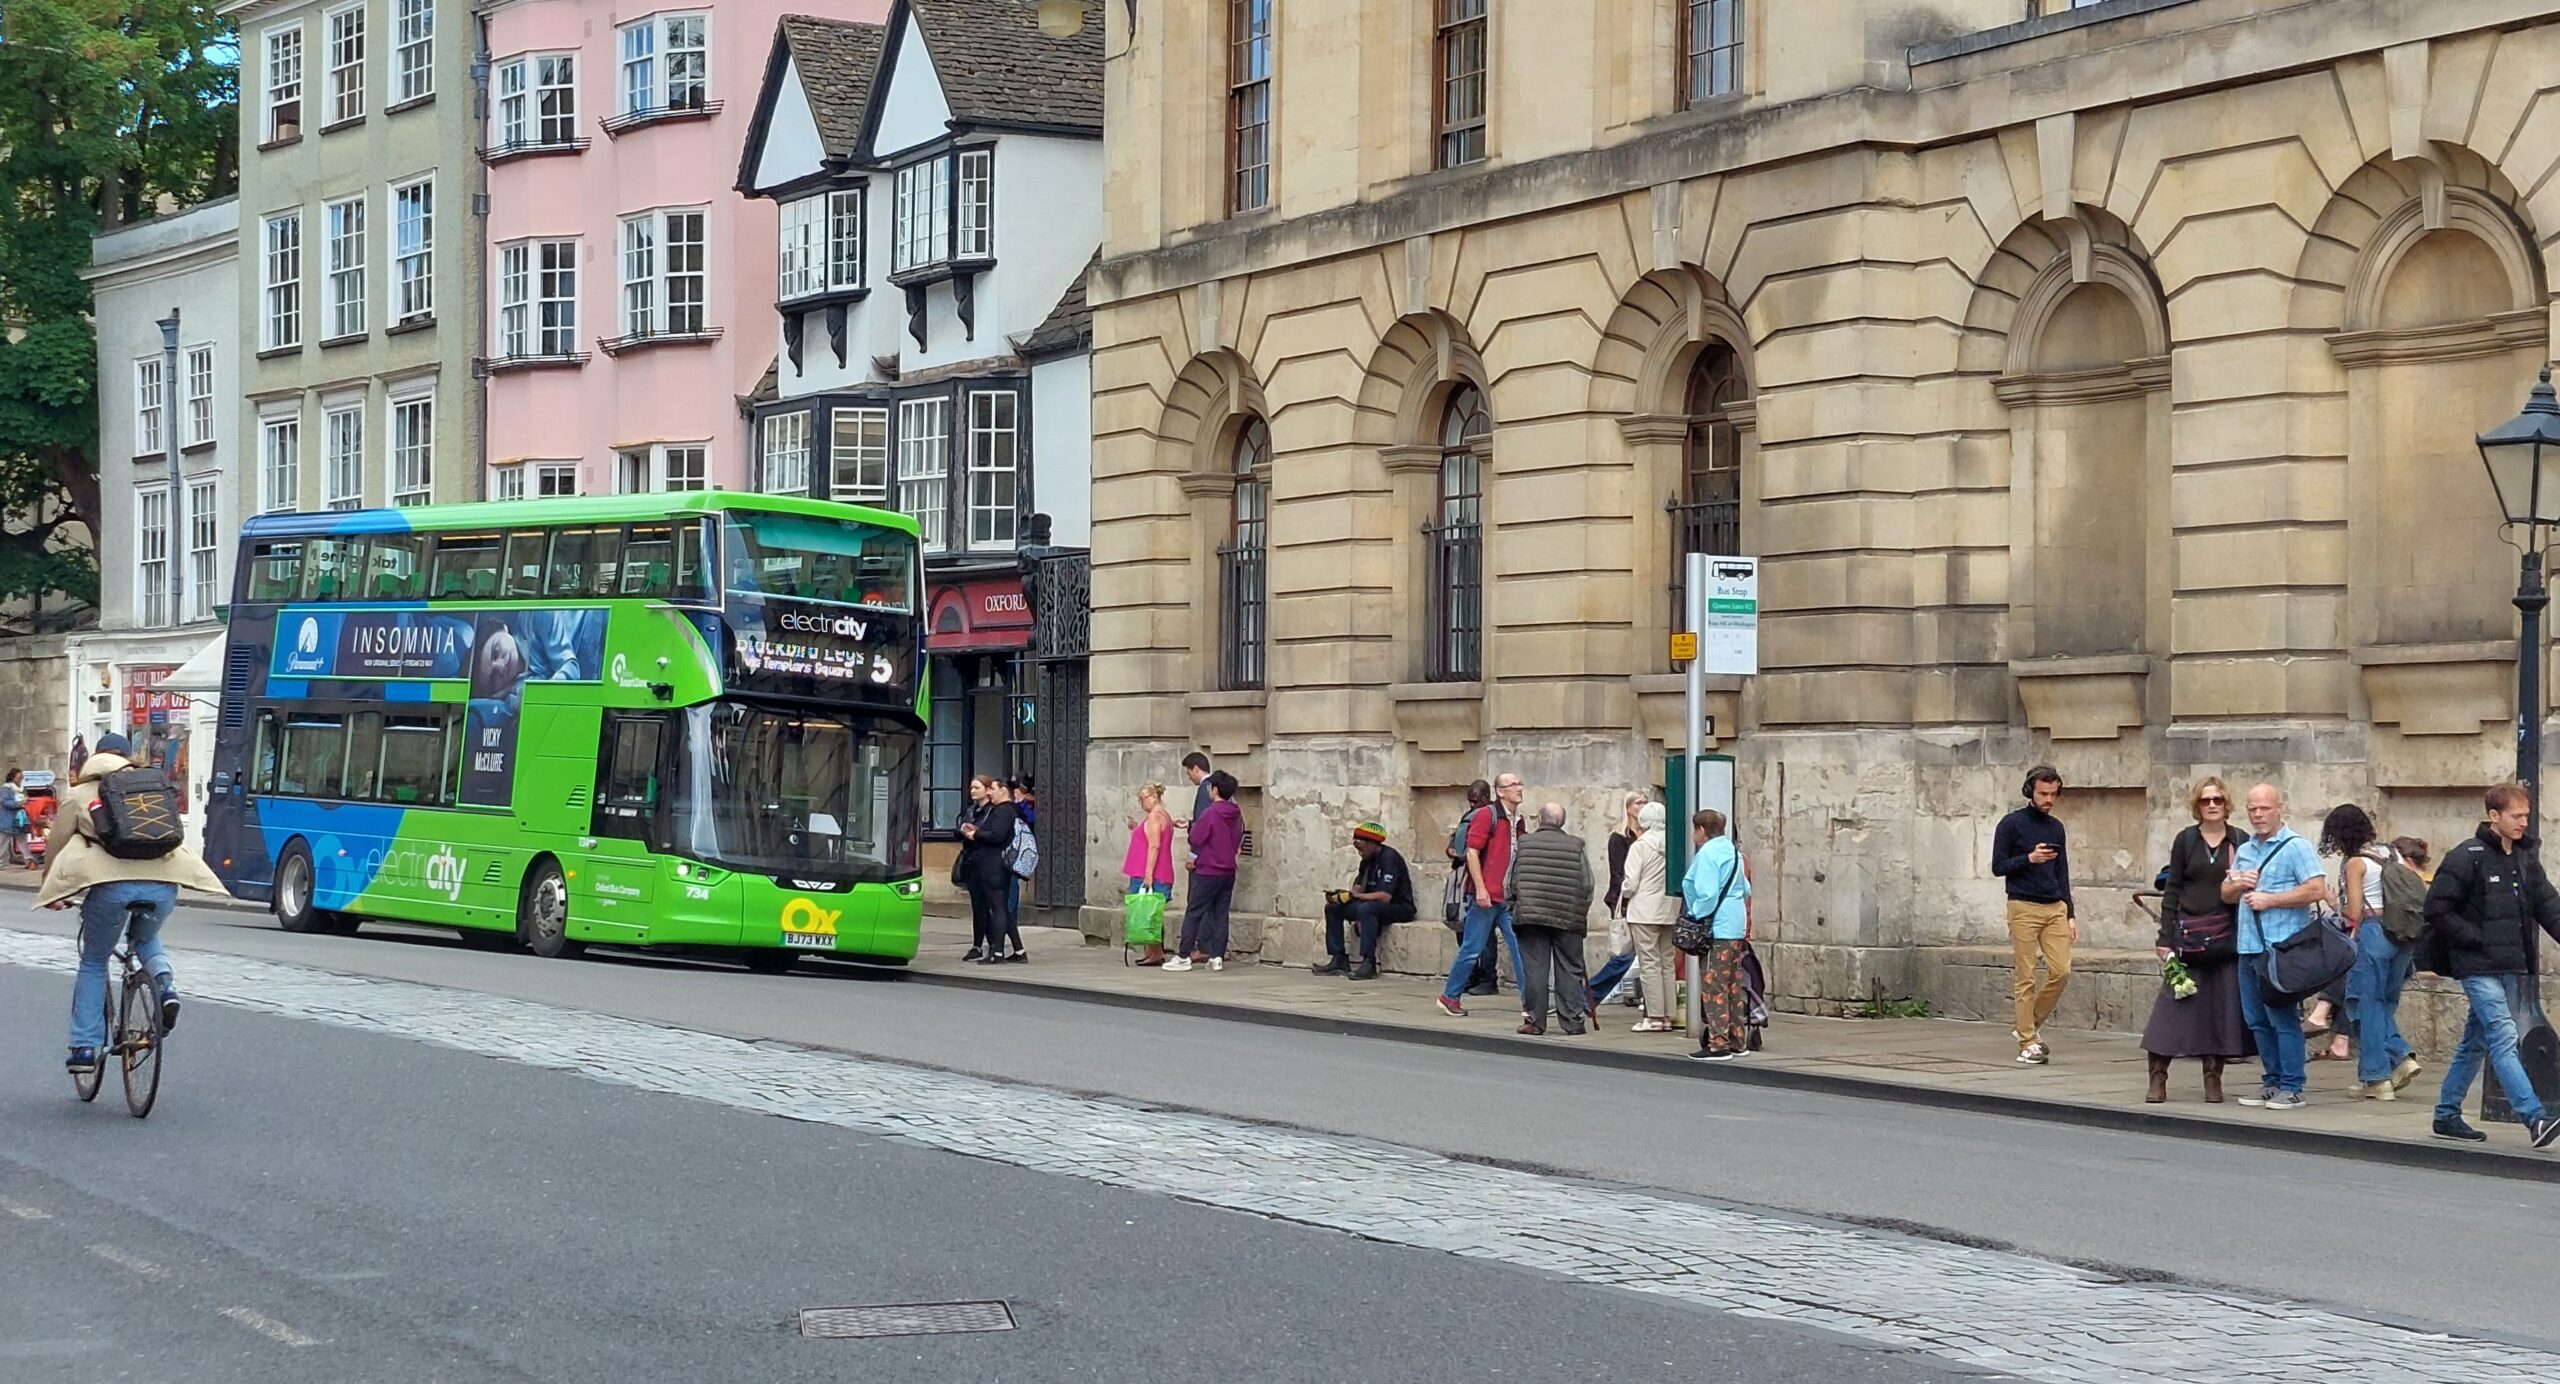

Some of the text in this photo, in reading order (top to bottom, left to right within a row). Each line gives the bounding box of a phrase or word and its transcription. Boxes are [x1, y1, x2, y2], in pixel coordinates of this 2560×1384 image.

[1717, 586, 1748, 598] Bus Stop
[780, 609, 867, 641] electricity
[352, 625, 456, 654] INSOMNIA
[763, 656, 813, 674] Templars
[814, 662, 854, 678] Square
[870, 654, 894, 684] 5
[483, 727, 502, 747] VICKY
[367, 838, 467, 901] electricity
[686, 886, 710, 901] 734
[787, 933, 834, 947] BJ73 WXX
